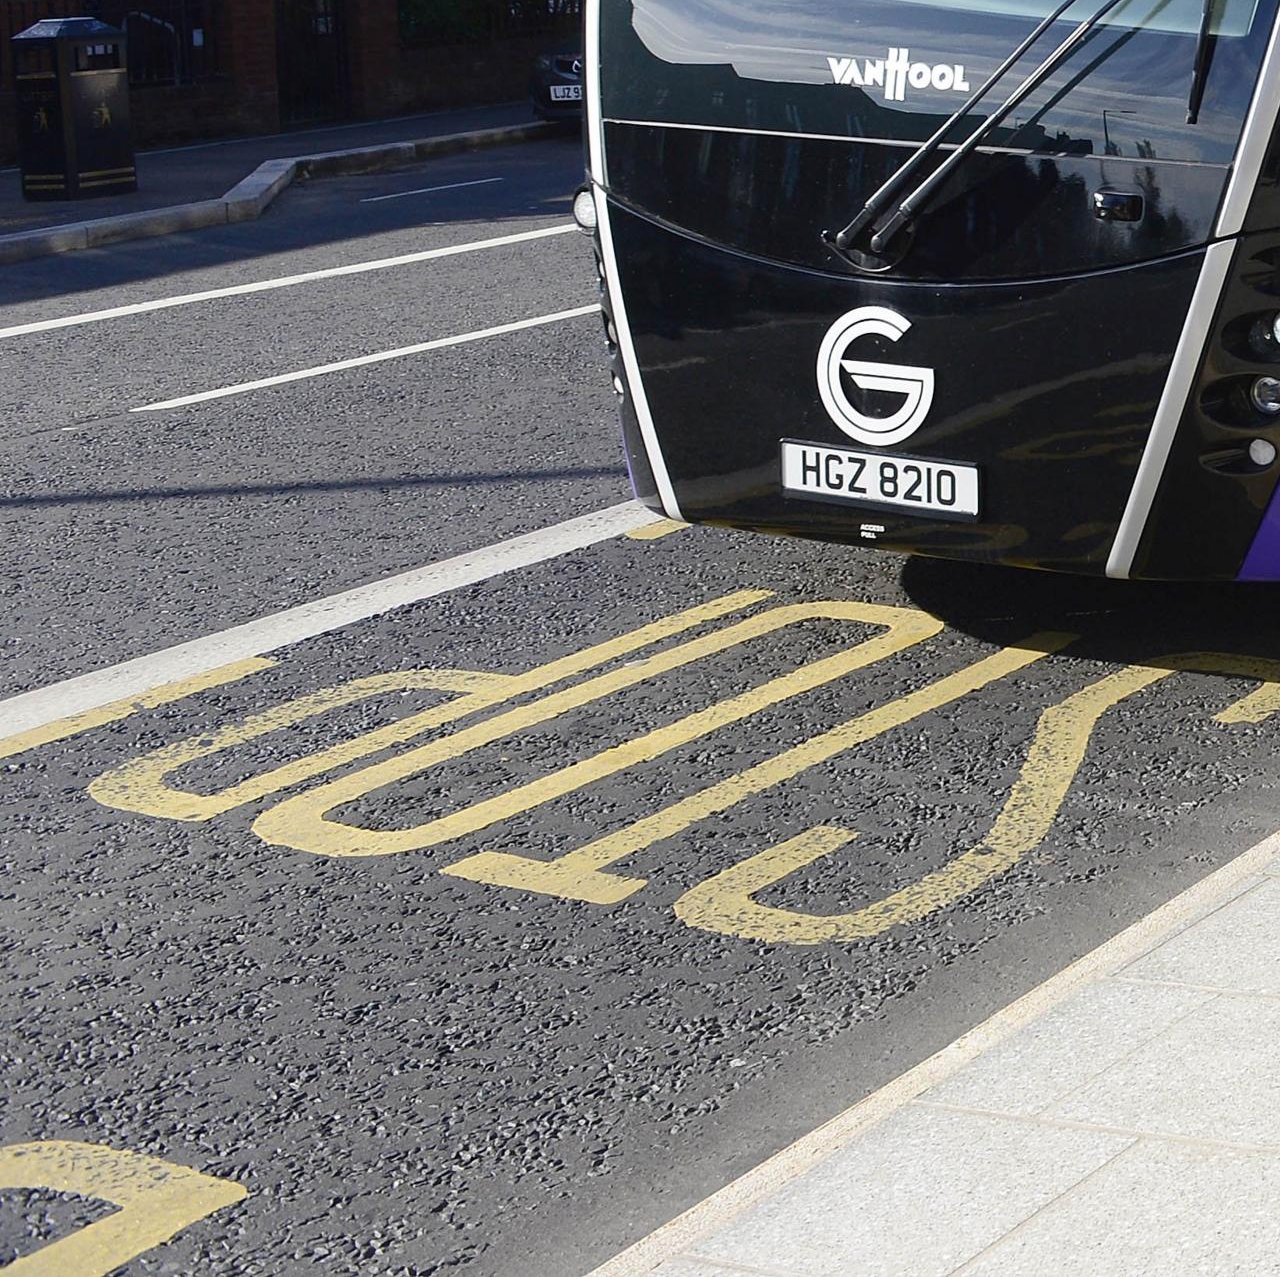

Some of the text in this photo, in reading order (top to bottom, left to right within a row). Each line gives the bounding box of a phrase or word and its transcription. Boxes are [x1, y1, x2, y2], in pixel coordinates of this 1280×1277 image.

[553, 87, 572, 99] LJZ
[802, 450, 956, 506] HGZ 8210
